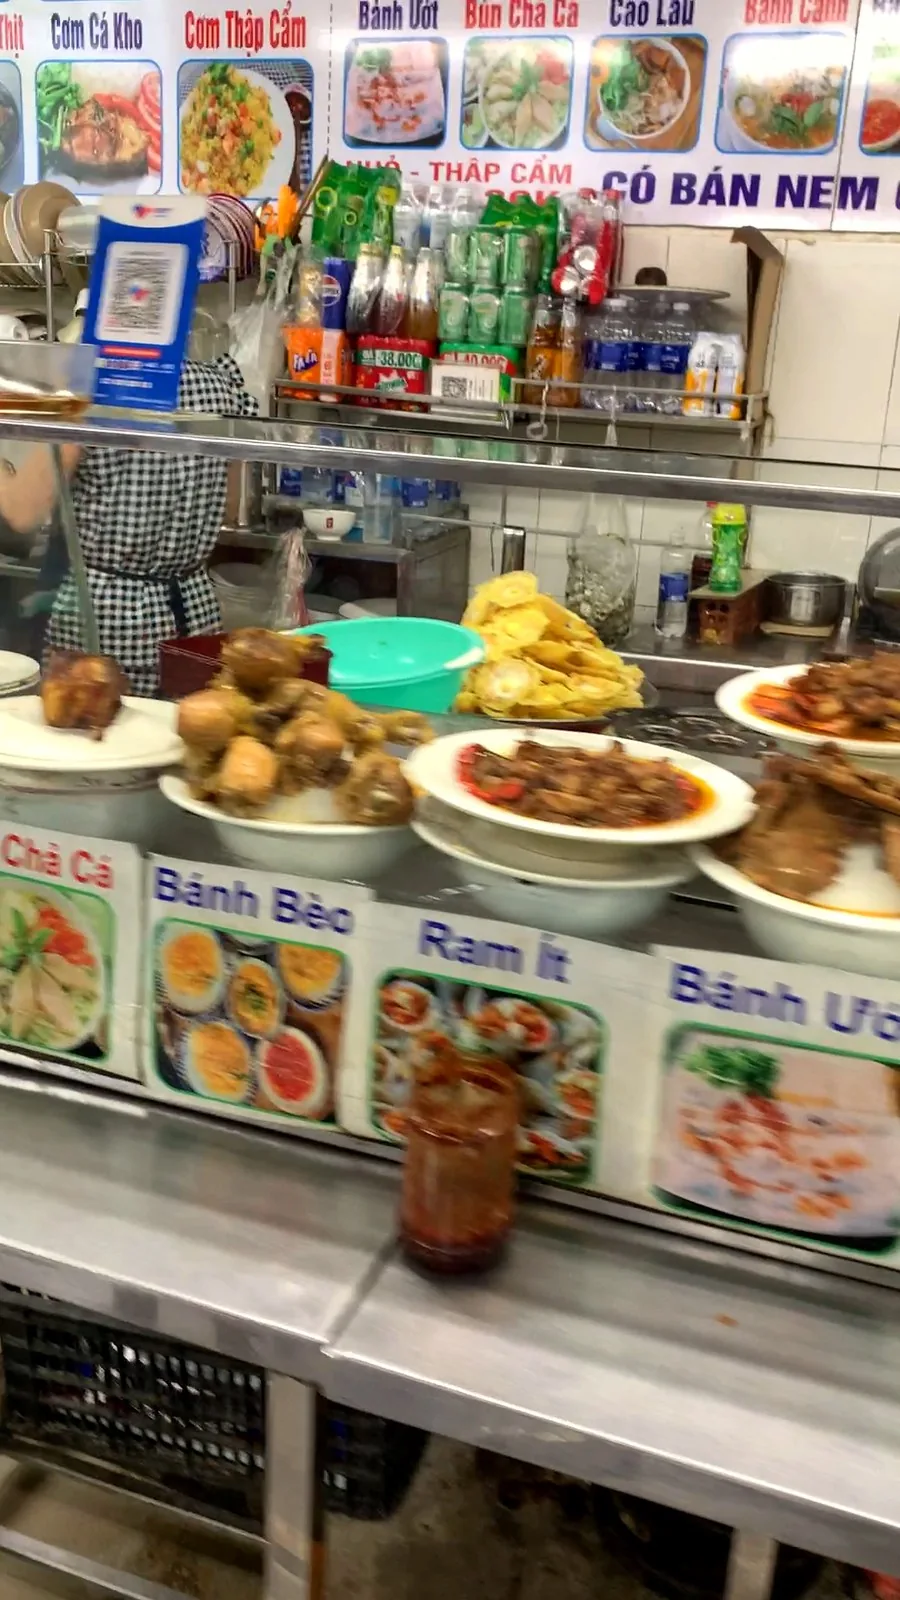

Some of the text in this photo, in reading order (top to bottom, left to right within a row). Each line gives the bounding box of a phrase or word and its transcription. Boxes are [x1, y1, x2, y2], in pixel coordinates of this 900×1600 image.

[51, 13, 143, 50] Cơm Cá Kho
[184, 1, 306, 57] Cơm Thập Cẩm
[670, 166, 760, 207] BÁN
[775, 174, 880, 211] NEM
[70, 849, 116, 889] Cá
[154, 866, 260, 919] Bánh
[418, 918, 525, 975] Ram
[669, 962, 808, 1026] Bánh
